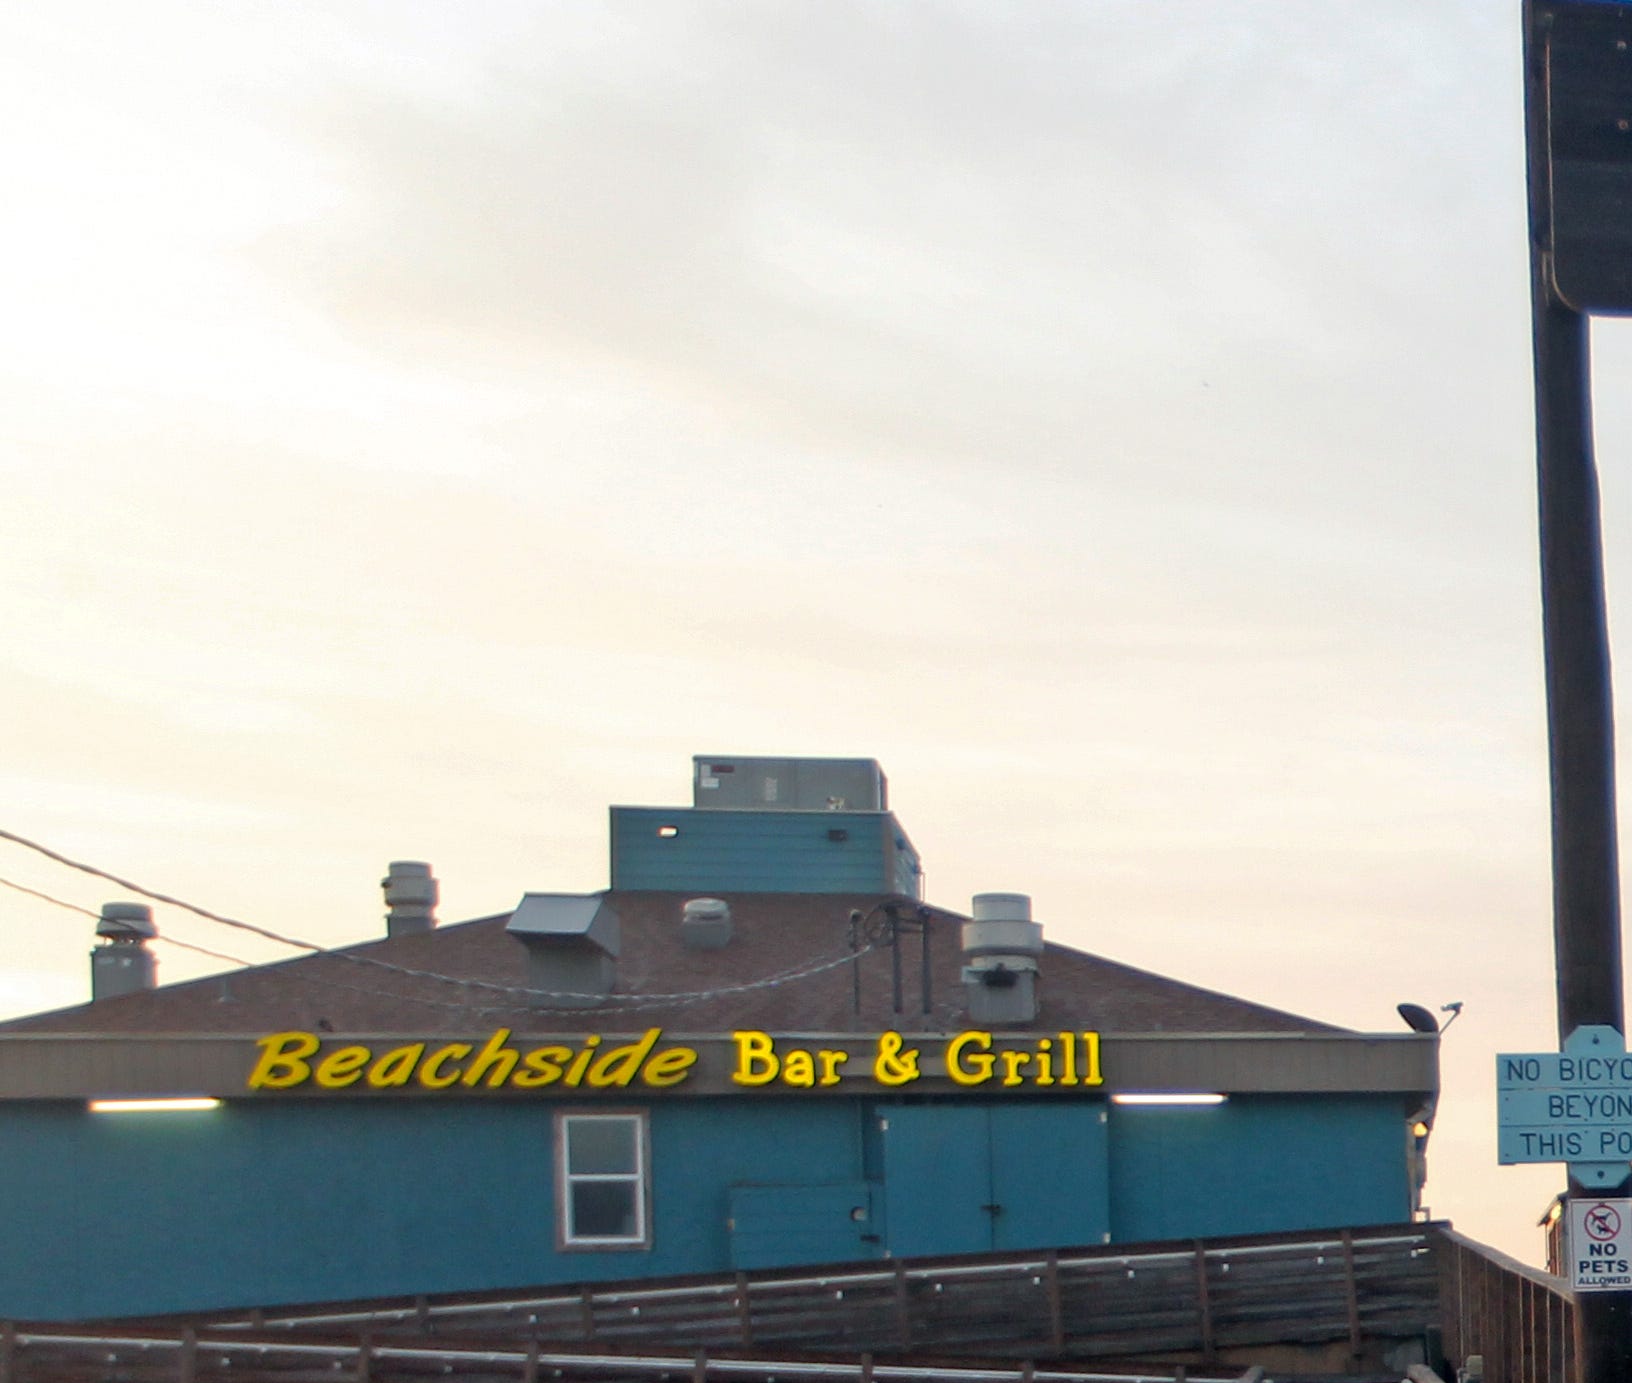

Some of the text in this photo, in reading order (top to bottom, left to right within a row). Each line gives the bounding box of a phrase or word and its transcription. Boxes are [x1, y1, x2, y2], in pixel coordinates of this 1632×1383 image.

[247, 1027, 1104, 1090] Beachside Bar & Grill
[1507, 1059, 1541, 1081] NO
[1519, 1132, 1582, 1156] THIS
[1589, 1243, 1617, 1256] NO
[1579, 1260, 1628, 1273] PETS
[1578, 1276, 1631, 1285] ALLOWED
